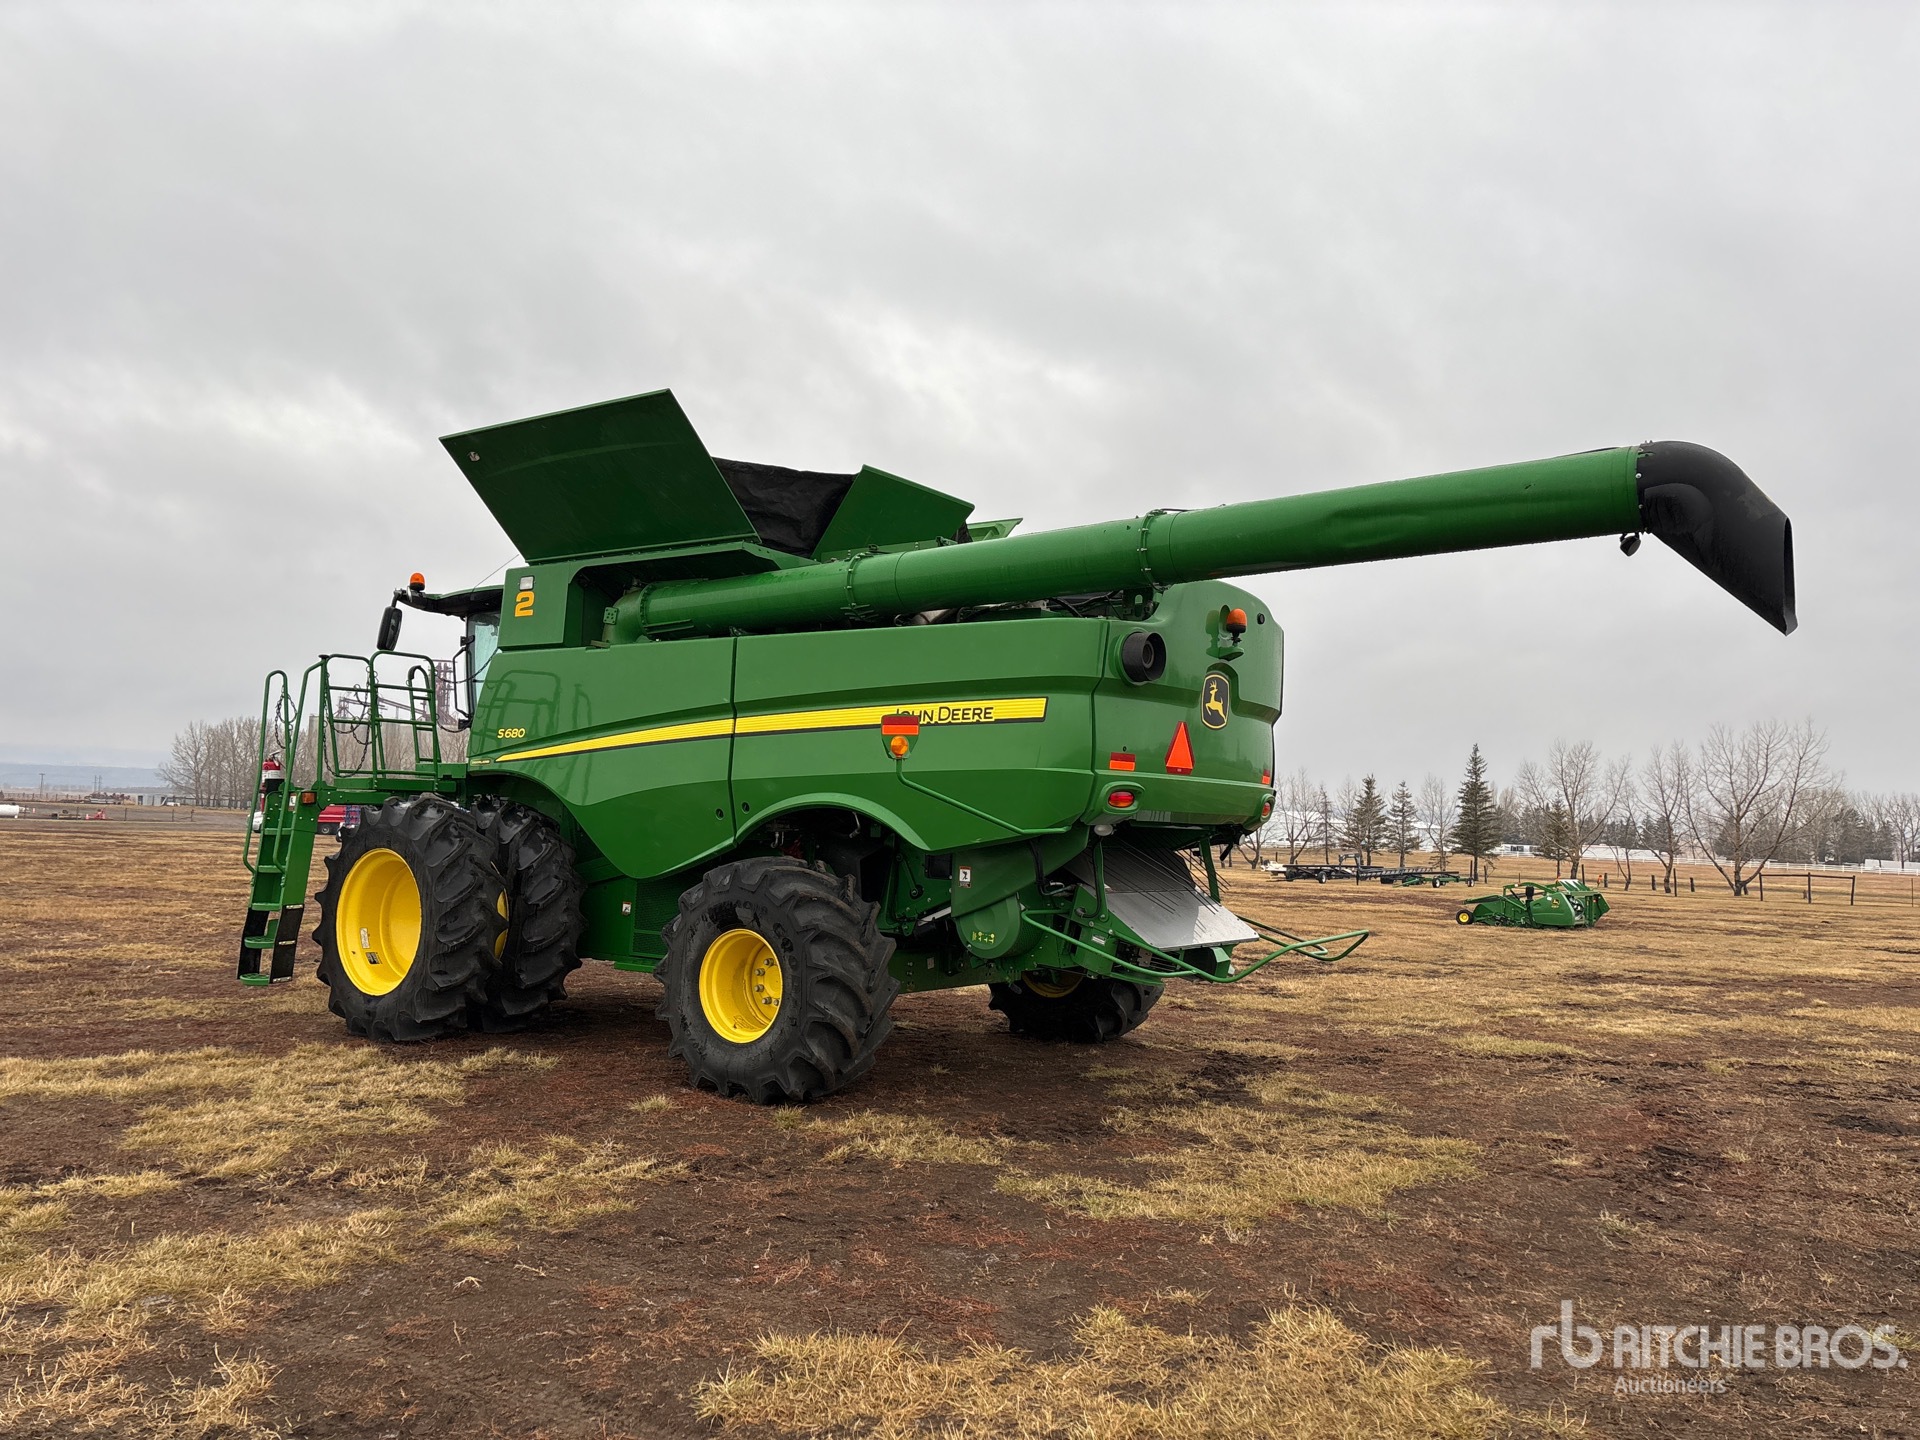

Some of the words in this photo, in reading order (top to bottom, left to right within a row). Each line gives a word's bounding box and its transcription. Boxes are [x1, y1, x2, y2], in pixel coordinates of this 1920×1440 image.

[514, 590, 535, 617] 2
[938, 706, 994, 721] DEERE
[497, 728, 526, 739] S680
